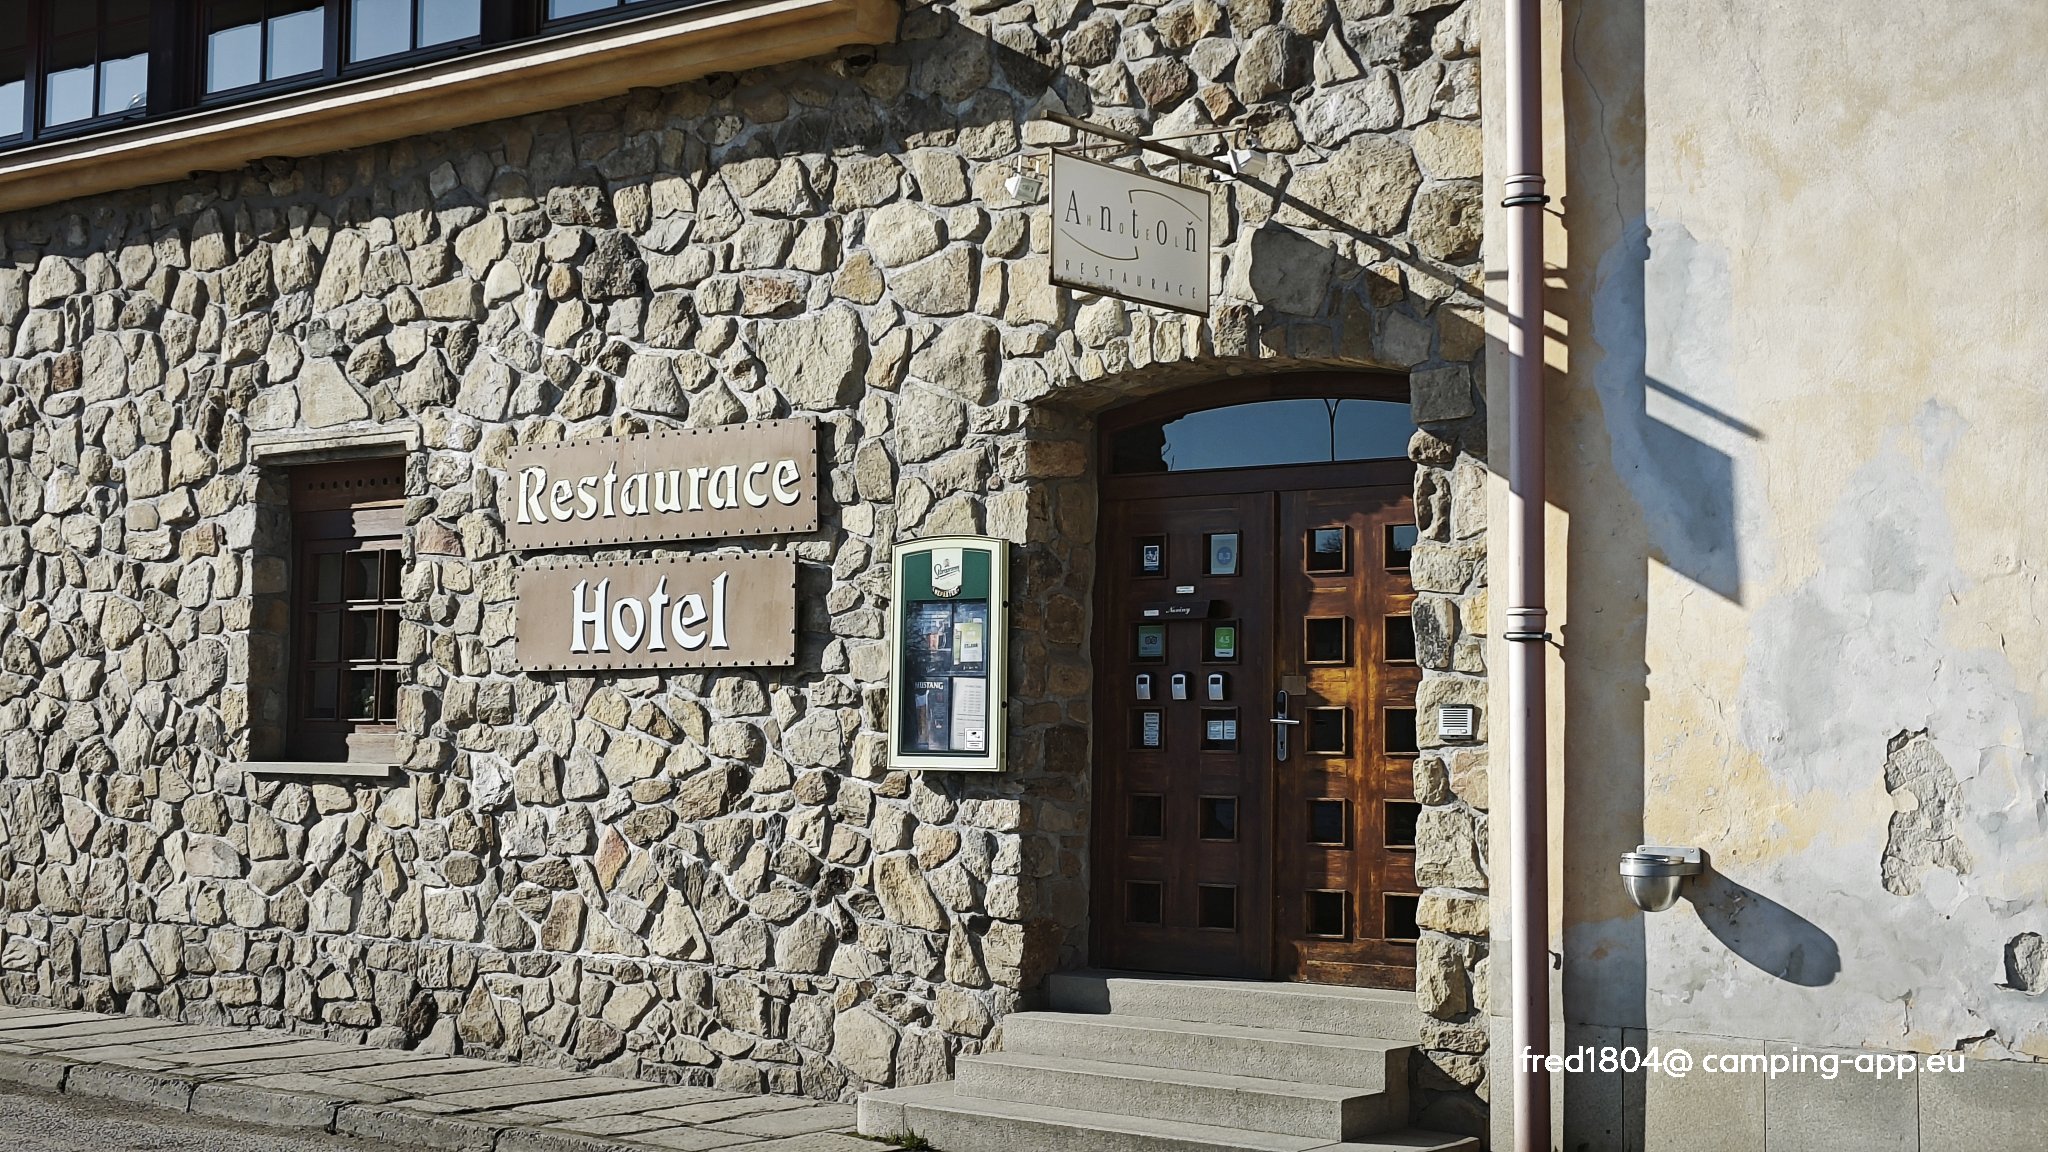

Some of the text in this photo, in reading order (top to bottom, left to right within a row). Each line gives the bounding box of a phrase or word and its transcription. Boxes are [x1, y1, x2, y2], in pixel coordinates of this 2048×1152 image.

[1065, 259, 1196, 300] RESTAURACE
[516, 459, 801, 524] Restaurace
[569, 570, 730, 654] Hotel
[914, 681, 944, 690] MUSTANG
